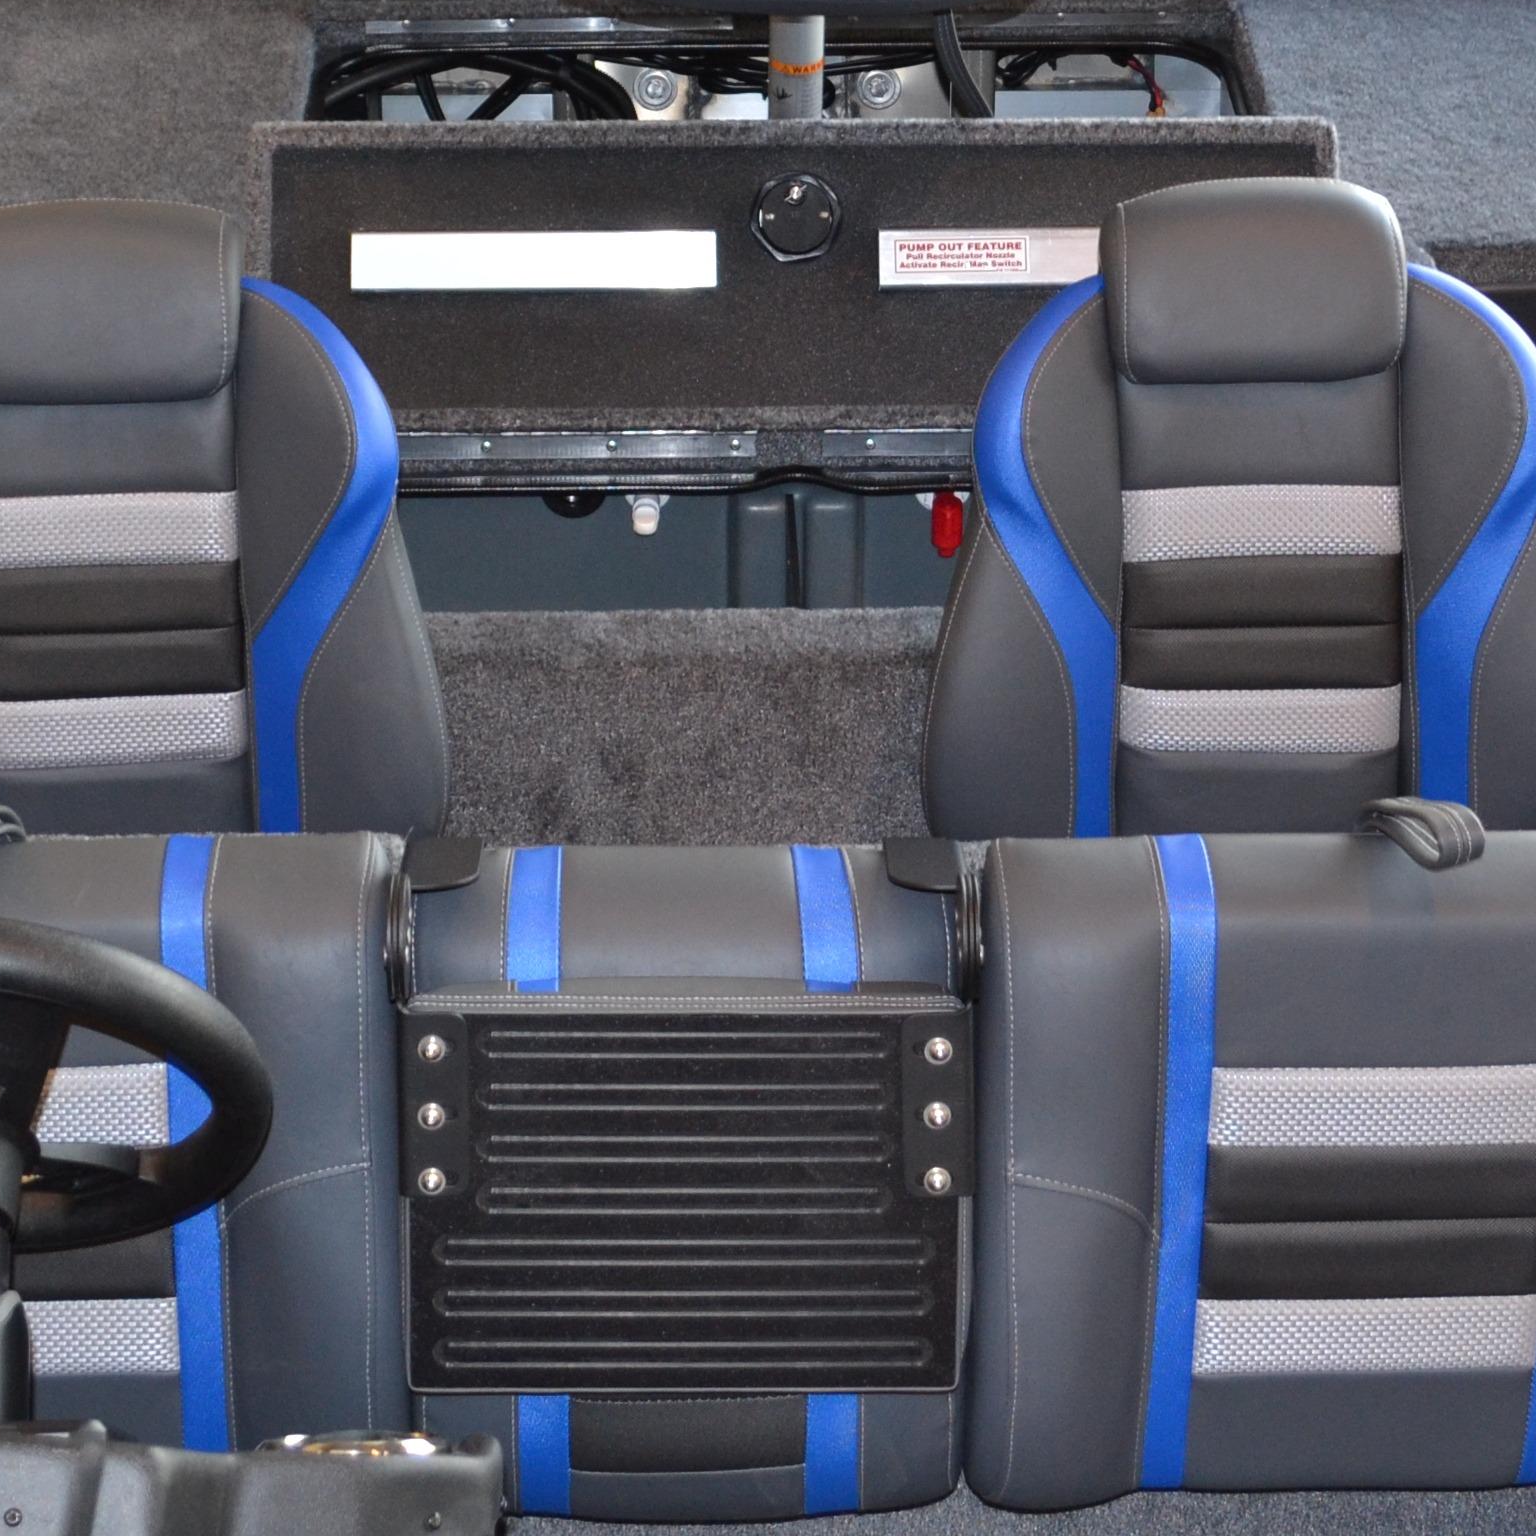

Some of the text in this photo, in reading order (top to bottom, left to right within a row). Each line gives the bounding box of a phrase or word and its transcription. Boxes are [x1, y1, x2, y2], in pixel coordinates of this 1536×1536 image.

[899, 241, 1022, 252] PUMP OUT FEATURE
[927, 252, 983, 260] Recirculator
[900, 261, 937, 269] Activate
[991, 260, 1023, 268] Switch
